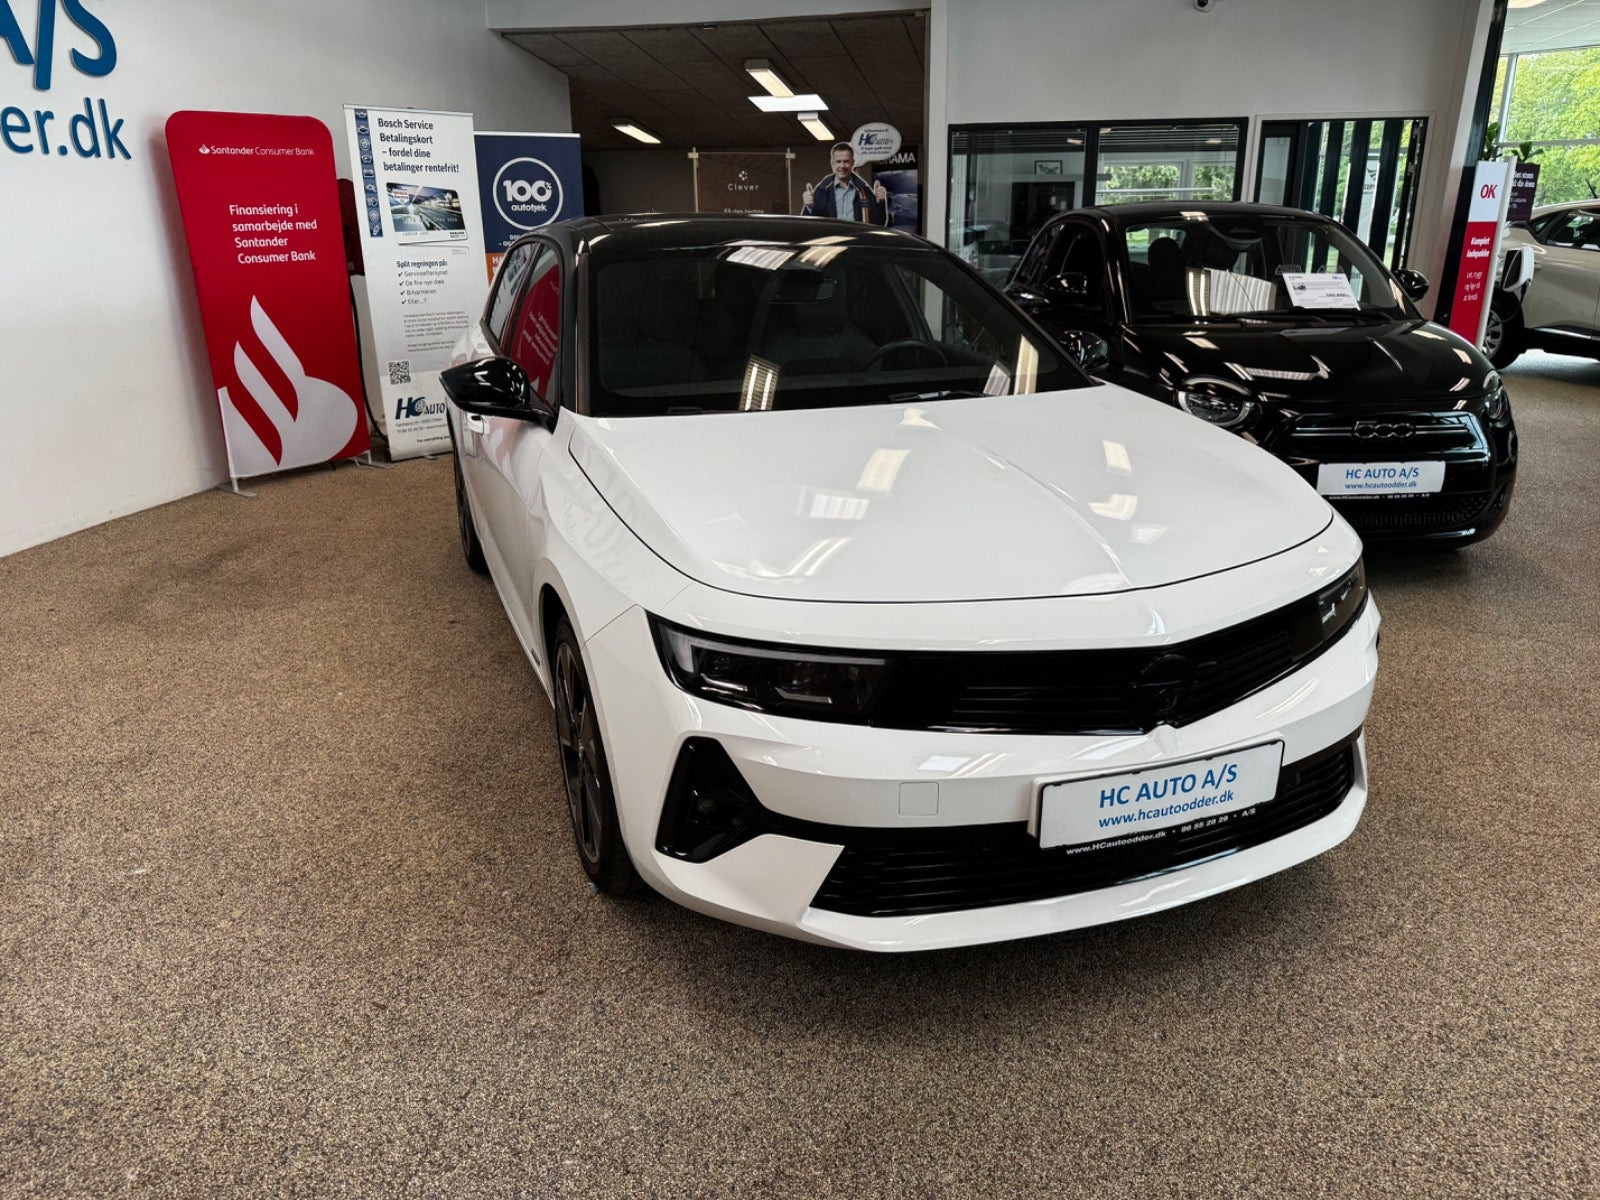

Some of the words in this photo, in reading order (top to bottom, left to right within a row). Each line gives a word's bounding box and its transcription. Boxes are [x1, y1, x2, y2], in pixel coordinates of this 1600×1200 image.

[378, 118, 403, 128] Bosch
[404, 120, 434, 130] Service
[380, 133, 433, 146] Betalingskort
[210, 146, 254, 155] Santander
[255, 147, 294, 156] Consumer
[389, 147, 413, 158] fordel
[414, 149, 431, 158] dine
[384, 162, 423, 174] betalinger
[425, 164, 460, 173] rentefrit!
[728, 183, 760, 191] Clever
[1480, 184, 1498, 199] OK
[229, 204, 294, 217] Finansiering
[294, 204, 299, 214] i
[511, 204, 547, 213] autotjek
[232, 220, 294, 233] samarbejde
[295, 219, 318, 230] med
[235, 236, 288, 248] Santander
[1471, 237, 1491, 247] Komplet
[238, 253, 289, 264] Consumer
[291, 250, 316, 261] Bank
[395, 397, 426, 420] HC
[424, 402, 446, 415] AUTO
[1354, 420, 1415, 439] 500
[1345, 469, 1362, 480] HC
[1364, 468, 1397, 479] AUTO
[1399, 467, 1420, 479] A/S
[1345, 481, 1417, 490] www.hcautoodder.dk
[1100, 785, 1131, 809] HC
[1135, 772, 1197, 803] AUTO
[1202, 764, 1238, 790] A/S
[1098, 790, 1234, 828] www.hcautoodder.dk
[1066, 830, 1168, 856] www.HCautoodder.dk
[1217, 815, 1229, 825] 29
[1241, 808, 1257, 818] A/S
